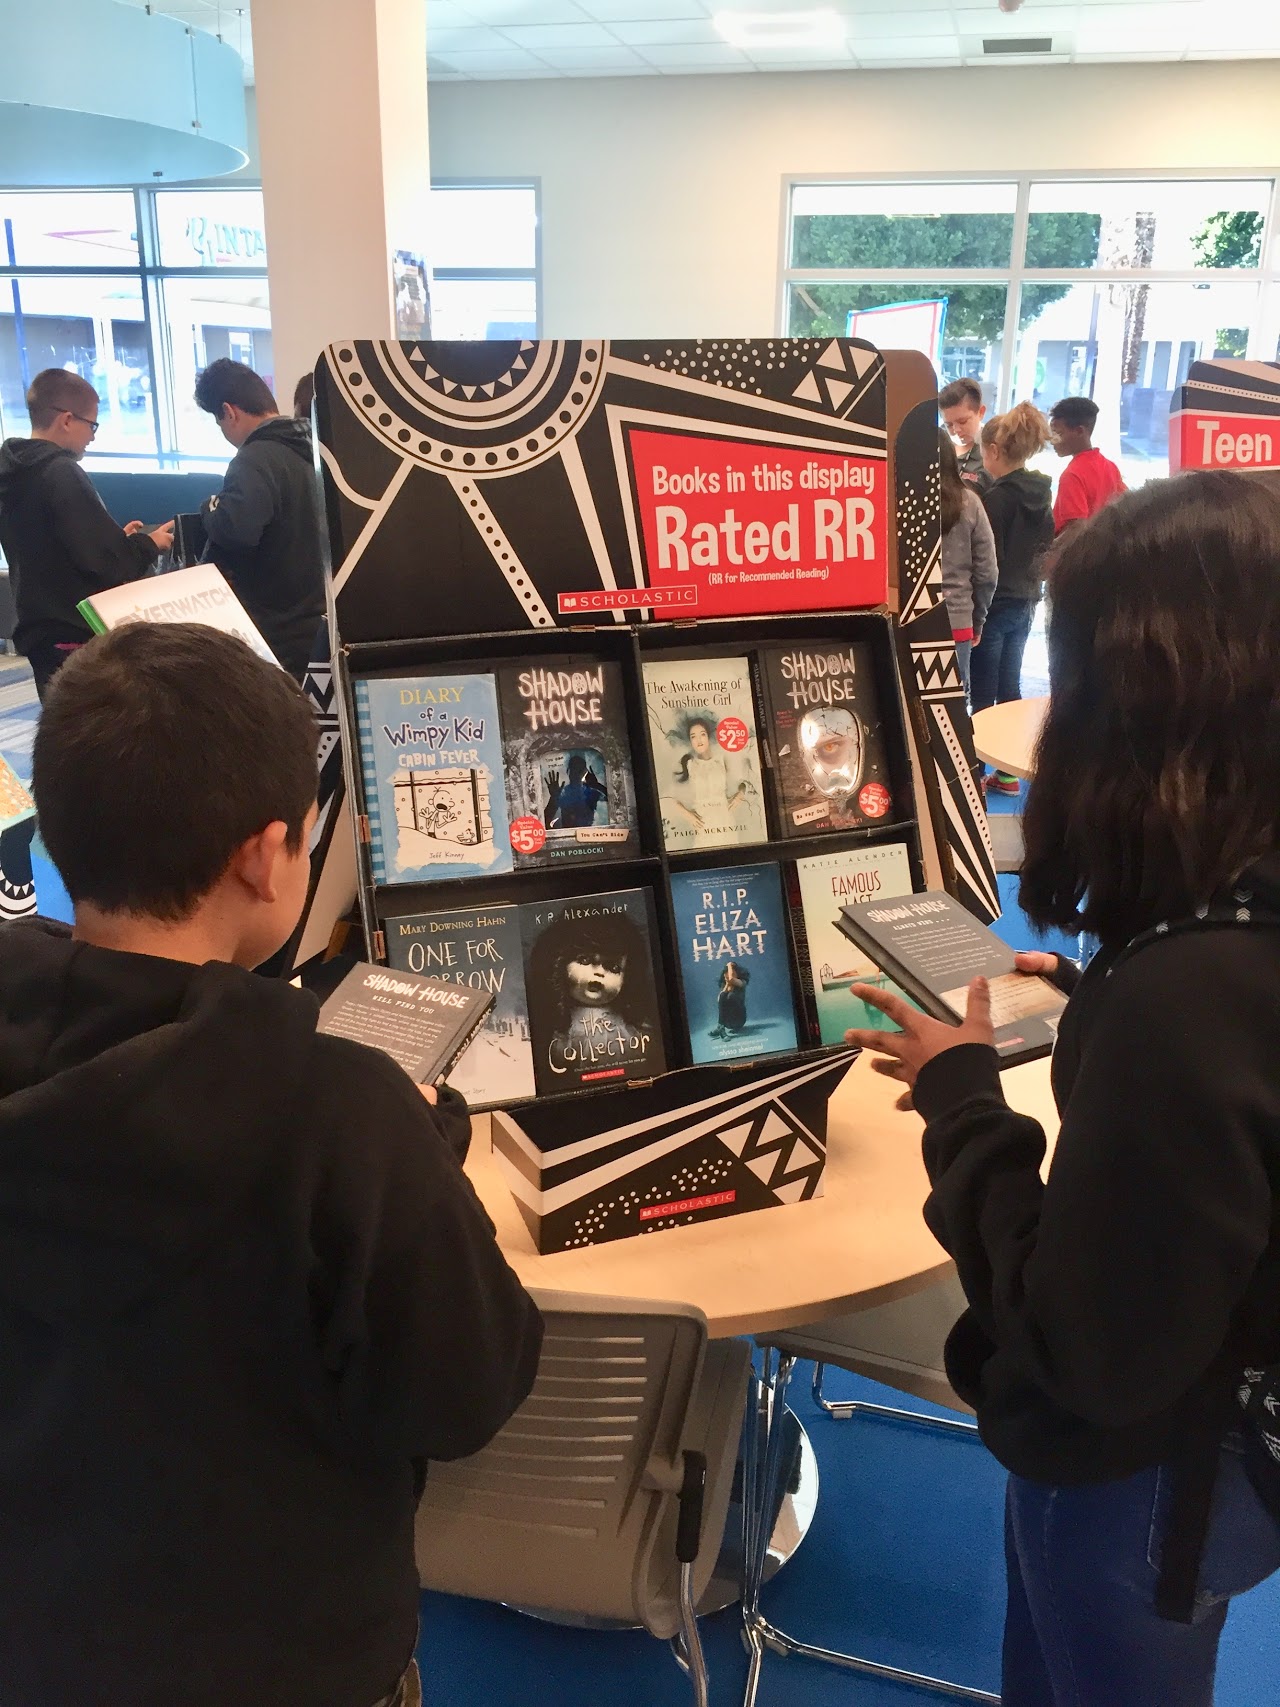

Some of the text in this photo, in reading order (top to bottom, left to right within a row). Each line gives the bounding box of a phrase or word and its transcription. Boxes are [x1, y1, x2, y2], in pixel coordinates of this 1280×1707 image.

[1197, 420, 1272, 465] Teen
[652, 460, 876, 496] Books in this display
[655, 497, 876, 571] Rated RR
[708, 566, 829, 586] (RR for Recommended Reading)
[580, 589, 694, 608] SCHOLASTIC
[780, 648, 856, 681] SHADOW
[518, 665, 604, 700] SHADOW
[644, 676, 743, 695] The Awakening of
[786, 678, 856, 709] HOUSE
[400, 686, 465, 706] DIARY
[661, 693, 732, 710] Sunshine Girl
[419, 707, 448, 721] of a
[523, 698, 603, 730] HOUSE
[382, 717, 486, 750] Wimpy Kid
[398, 749, 480, 768] CABIN FEVER
[674, 828, 700, 838] PAIGE
[551, 850, 566, 858] DAN
[803, 858, 839, 869] KATIE
[848, 850, 903, 863] ALENDER
[831, 870, 881, 897] FAMOUS
[563, 902, 629, 922] Alexander
[702, 888, 749, 910] R.I.P.
[866, 900, 950, 924] SHADOW HOUSE
[695, 908, 762, 935] ELIZA
[408, 937, 505, 973] ONE FOR
[692, 930, 768, 963] HART
[363, 974, 469, 1009] SHADOW HOUSE
[430, 967, 506, 994] RROW
[419, 1005, 434, 1014] YOU
[579, 1010, 617, 1036] the
[548, 1032, 651, 1073] Collector
[653, 1192, 733, 1217] SCHOLASTIC
